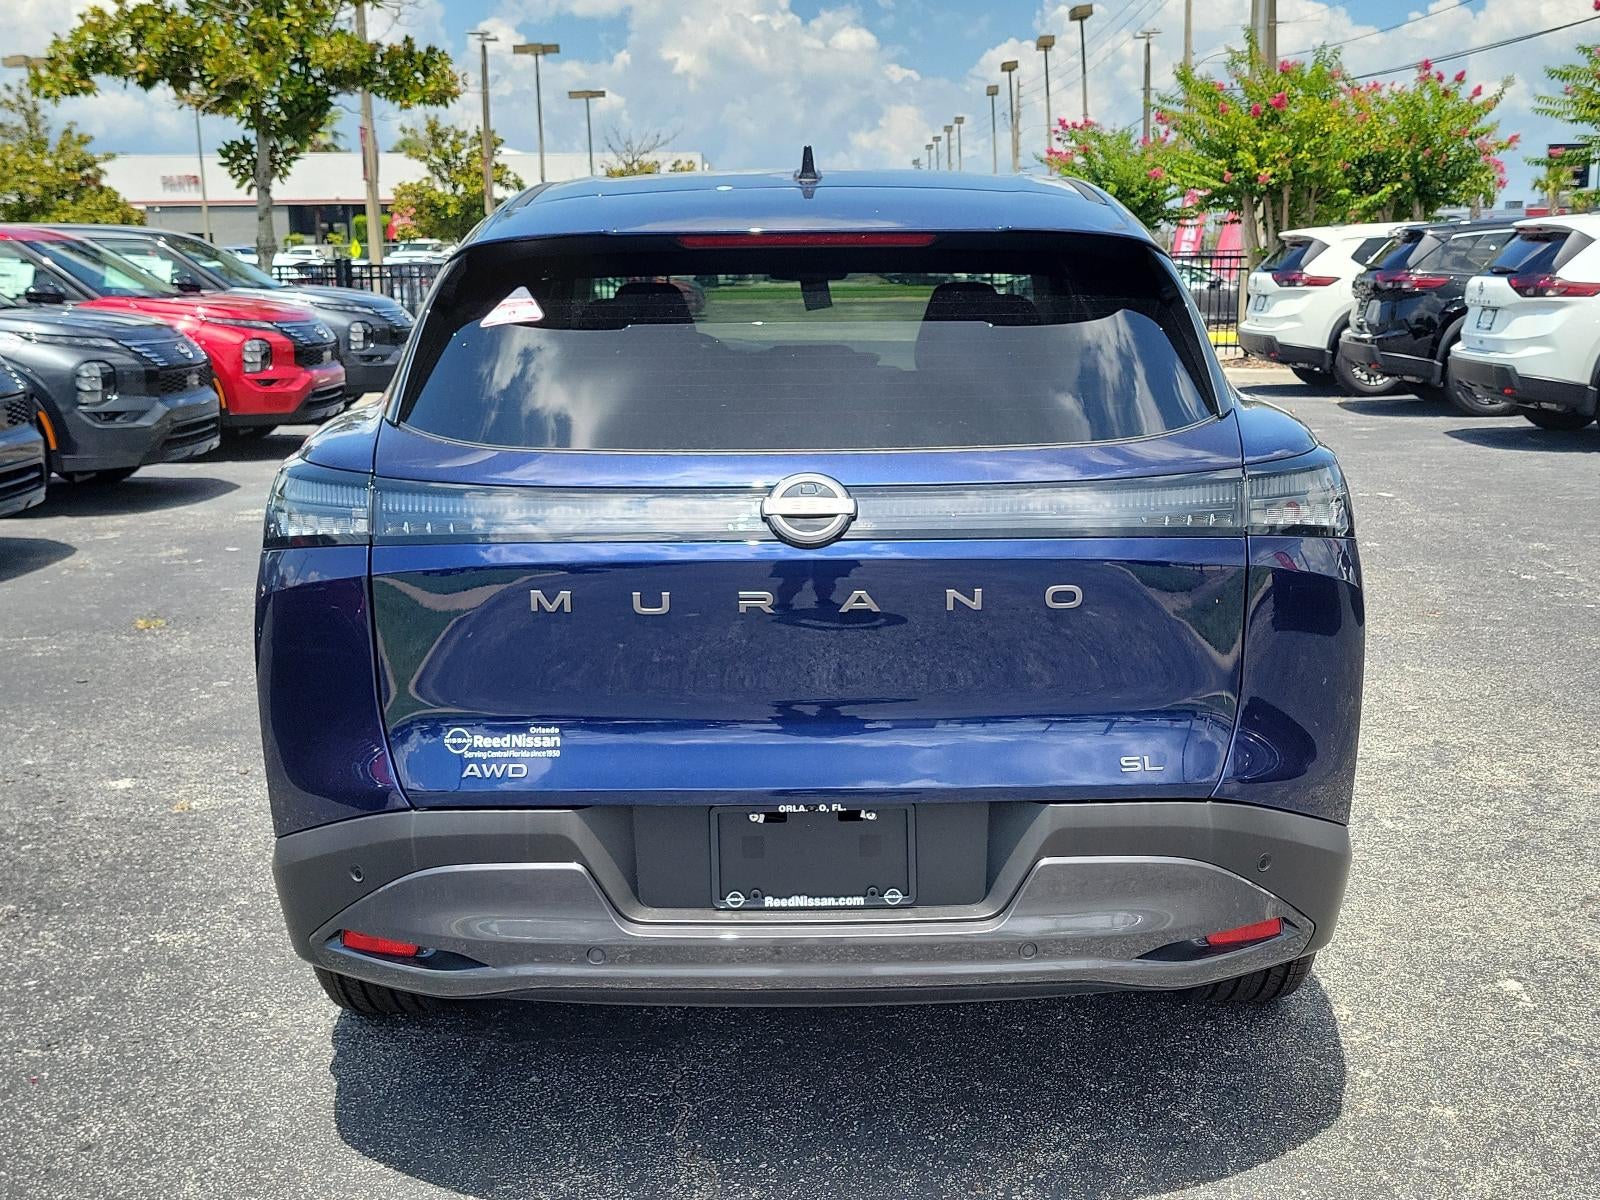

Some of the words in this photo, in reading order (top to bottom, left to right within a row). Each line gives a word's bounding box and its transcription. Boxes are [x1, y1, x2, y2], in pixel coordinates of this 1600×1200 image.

[530, 584, 1083, 615] MURANO
[464, 750, 487, 759] Serving
[487, 750, 509, 758] Central
[509, 750, 530, 758] Florida
[530, 750, 546, 758] since
[462, 763, 528, 778] AWD
[1120, 756, 1164, 772] SL
[778, 804, 829, 813] ORLAO,
[764, 895, 864, 907] ReedNissan.com
